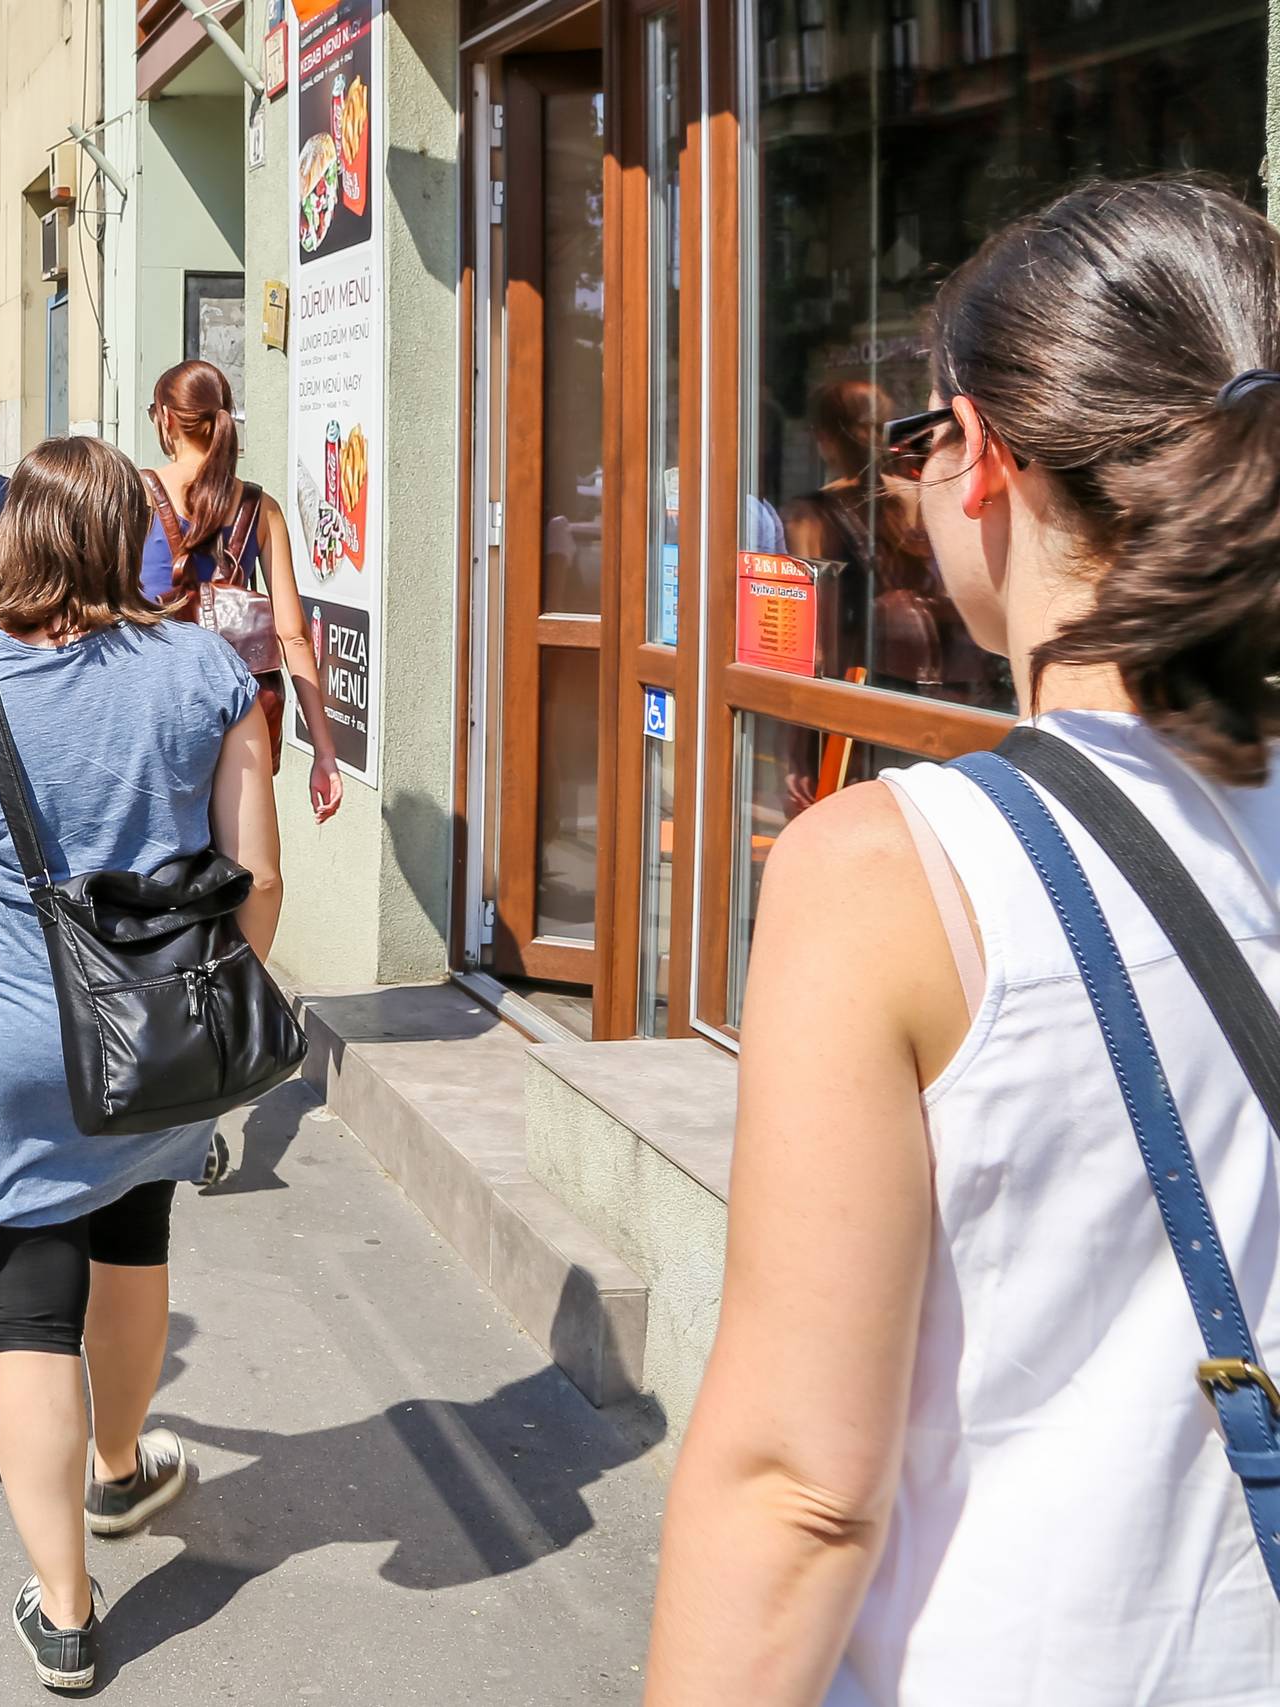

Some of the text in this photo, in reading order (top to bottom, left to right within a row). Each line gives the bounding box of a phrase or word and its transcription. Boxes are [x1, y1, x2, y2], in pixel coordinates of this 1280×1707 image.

[300, 266, 371, 320] DÜRÜM MENÜ
[328, 623, 368, 667] PIZZA
[328, 664, 368, 710] MENÜ
